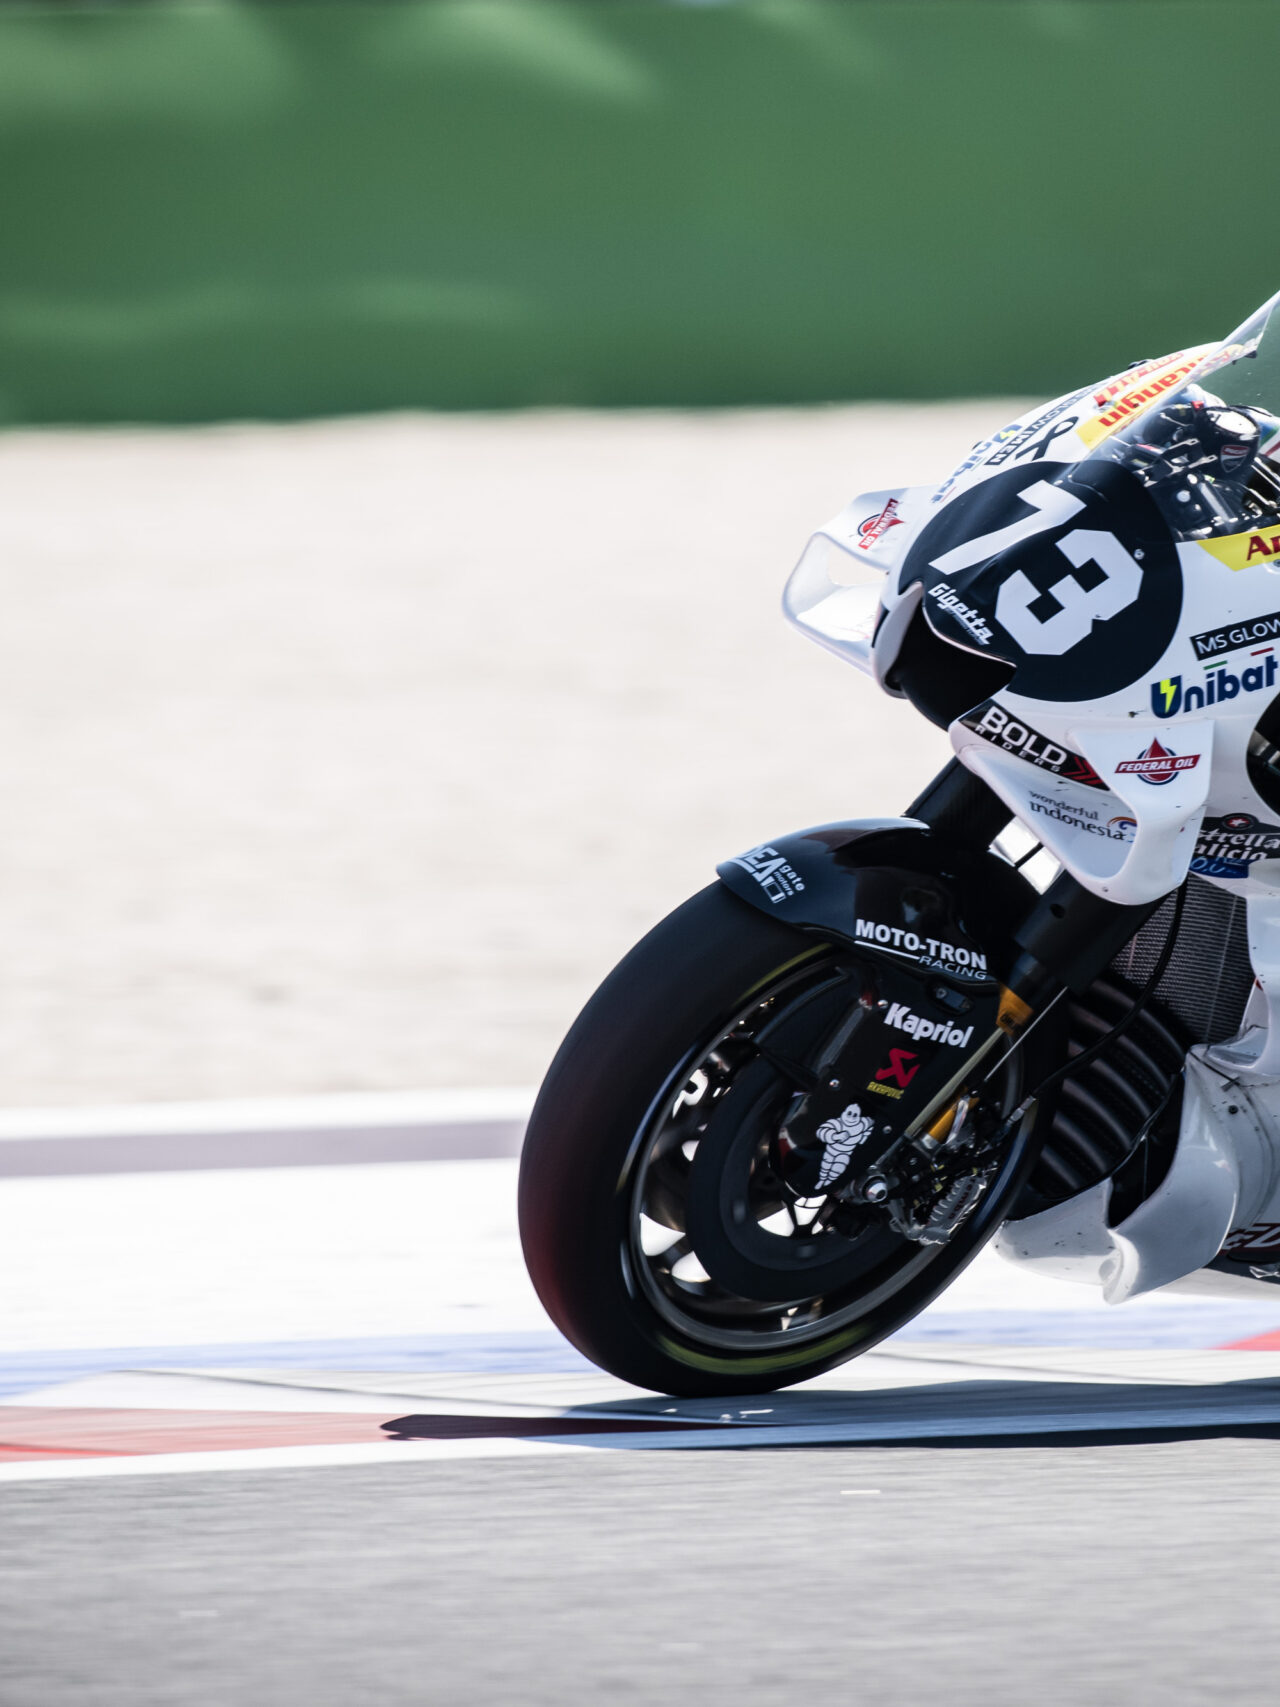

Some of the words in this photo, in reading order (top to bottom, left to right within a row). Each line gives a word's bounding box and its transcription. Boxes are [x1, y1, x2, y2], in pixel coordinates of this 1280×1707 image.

[928, 480, 1144, 656] 73
[1196, 636, 1228, 655] MS
[1151, 655, 1279, 719] Unibat
[975, 725, 1060, 772] RIDERS
[980, 706, 1067, 765] BOLD
[1118, 759, 1172, 772] FEDERAL
[1175, 757, 1195, 769] OIL
[1029, 791, 1099, 820] wonderful
[774, 871, 794, 896] motors
[780, 865, 805, 891] gate
[855, 919, 987, 970] MOTO-TRON
[919, 956, 987, 980] RACING
[883, 1002, 975, 1048] Kapriol
